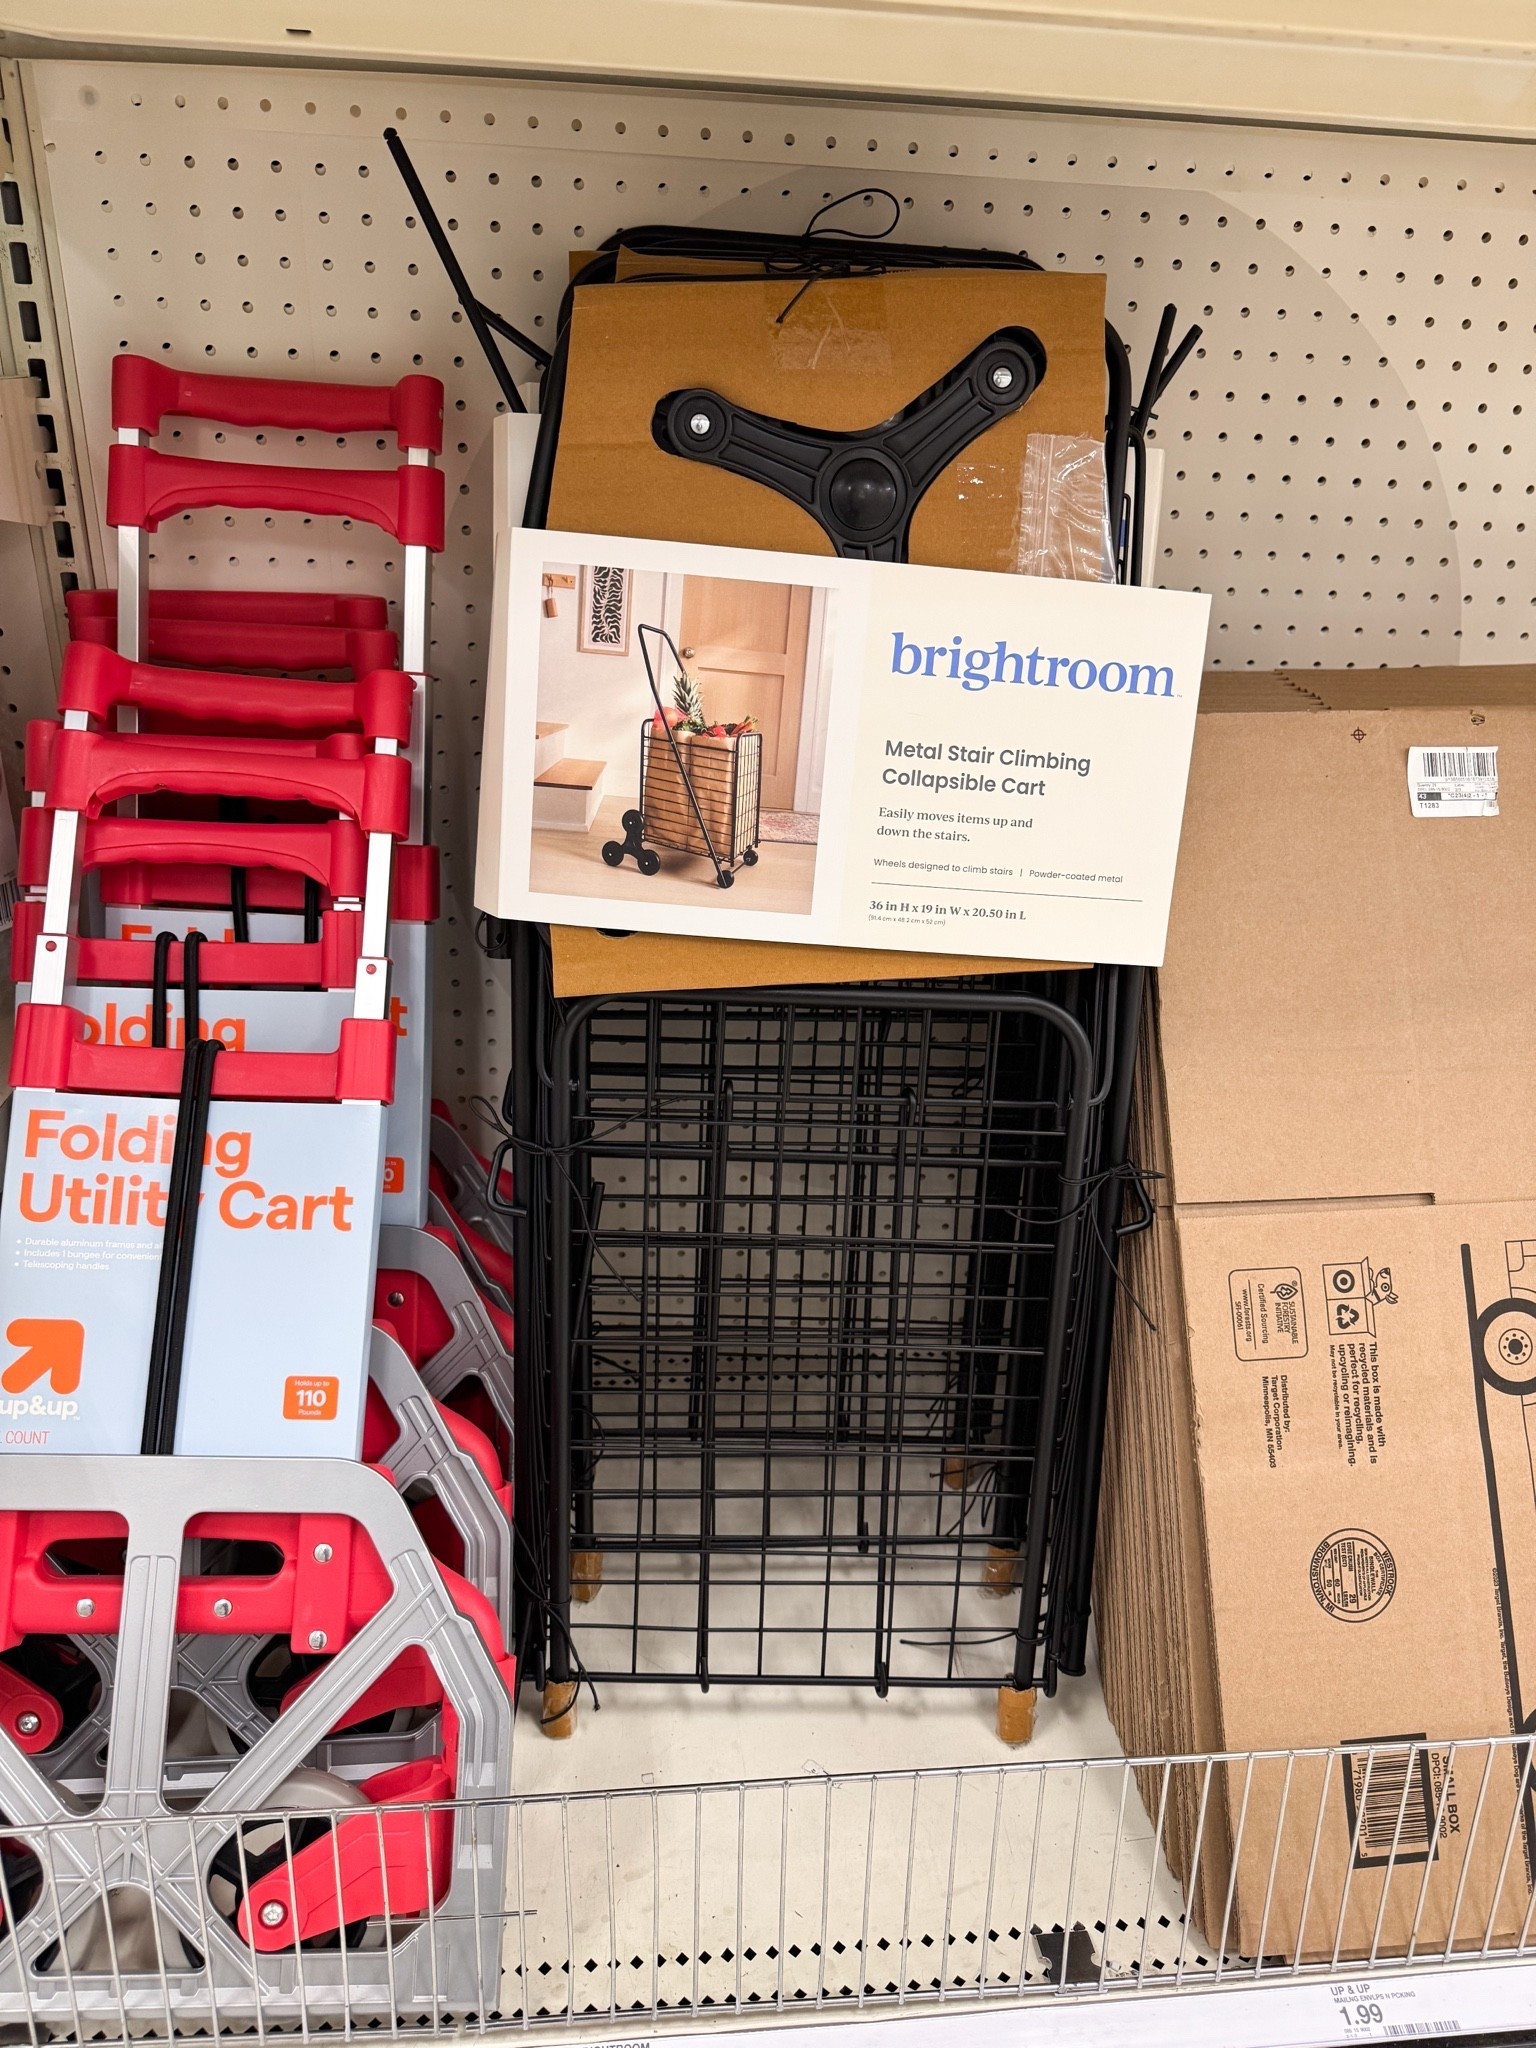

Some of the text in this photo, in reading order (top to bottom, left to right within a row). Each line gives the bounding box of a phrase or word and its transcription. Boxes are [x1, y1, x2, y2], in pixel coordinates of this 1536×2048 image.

[891, 631, 1175, 697] brightroom
[885, 740, 1091, 776] Metal Stair Climbing
[882, 768, 1045, 796] Collapsible Cart
[878, 807, 1033, 828] Easily moves items up and
[876, 826, 970, 842] down the stairs.
[873, 859, 906, 868] Wheels
[908, 861, 950, 873] designed
[962, 864, 987, 875] climb
[990, 867, 1012, 876] stairs
[1029, 870, 1096, 882] Powder-coated
[1098, 874, 1122, 883] metal
[869, 900, 883, 910] 36
[886, 901, 897, 911] in
[900, 903, 910, 912] H
[921, 904, 932, 914] 19
[935, 905, 946, 914] in
[950, 906, 962, 915] W
[972, 908, 1002, 918] 20.50
[1005, 910, 1016, 920] in
[1019, 911, 1026, 920] L
[219, 1181, 354, 1232] Cart
[24, 1250, 60, 1258] Includes
[68, 1251, 100, 1260] bungee
[102, 1252, 115, 1260] for
[25, 1238, 59, 1246] Durable
[60, 1239, 103, 1248] aluminum
[106, 1240, 135, 1248] frames
[23, 1260, 109, 1270] Telescoping handles
[1235, 1301, 1243, 1330] SFI-00061
[1242, 1289, 1252, 1342] www.forests.org
[1258, 1284, 1269, 1344] Certified Sourcing
[1275, 1302, 1284, 1333] INITIATIVE
[1282, 1302, 1290, 1334] FORESTRY
[1289, 1302, 1298, 1344] SUSTAINABLE
[1370, 1342, 1378, 1362] This
[1332, 1371, 1338, 1379] be
[296, 1390, 326, 1407] 110
[1280, 1374, 1290, 1419] Distributed
[1348, 1343, 1364, 1444] perfect for recycling,
[1359, 1342, 1378, 1464] recycled materials and is
[1373, 1386, 1381, 1394] is
[1271, 1374, 1282, 1450] Target Corporation
[1338, 1344, 1356, 1467] upcycling or reimagining.
[1374, 1396, 1383, 1423] made
[1262, 1376, 1276, 1468] Minneapolis, MN 55403
[6, 1431, 51, 1444] COUNT
[1376, 1426, 1386, 1447] with
[1312, 1540, 1335, 1612] BROWNSTOWN, MI
[1376, 1563, 1386, 1596] CERTIFICATE
[1382, 1550, 1394, 1596] WESTROCK
[1349, 1594, 1356, 1604] 29
[1432, 1753, 1441, 1780] DPCI:
[1353, 1769, 1362, 1800] 71980
[1448, 1804, 1460, 1834] BOX
[1330, 1984, 1370, 1996] UP & UP
[1334, 1996, 1358, 2004] MAILNG
[1360, 1994, 1384, 2002] ENVLPS
[1340, 2004, 1383, 2026] 1.99
